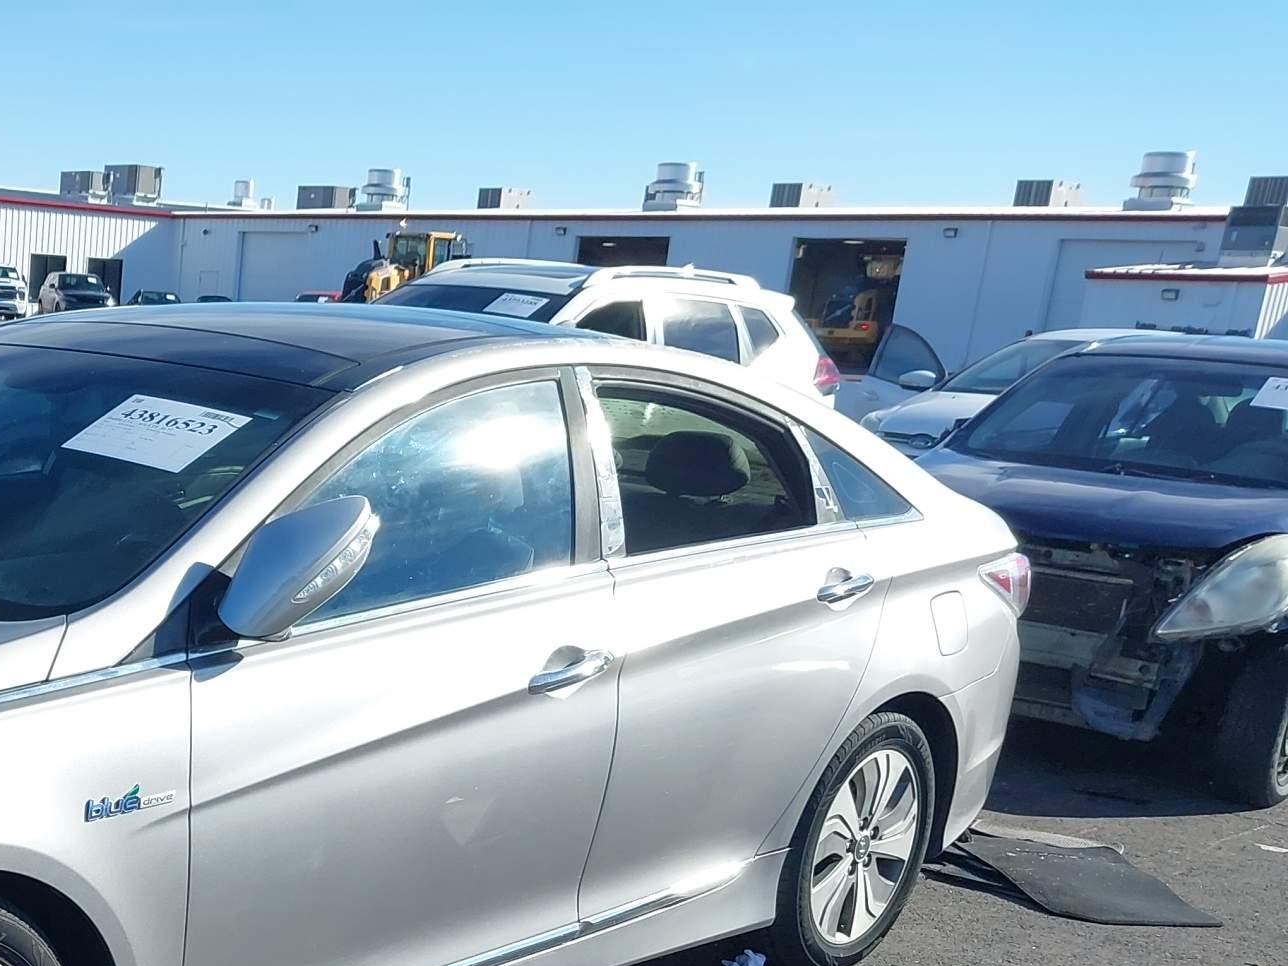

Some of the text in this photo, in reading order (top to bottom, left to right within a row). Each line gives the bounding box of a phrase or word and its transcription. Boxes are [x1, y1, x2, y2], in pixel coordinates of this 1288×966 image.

[121, 408, 219, 436] 43816523
[84, 789, 175, 822] blue drive
